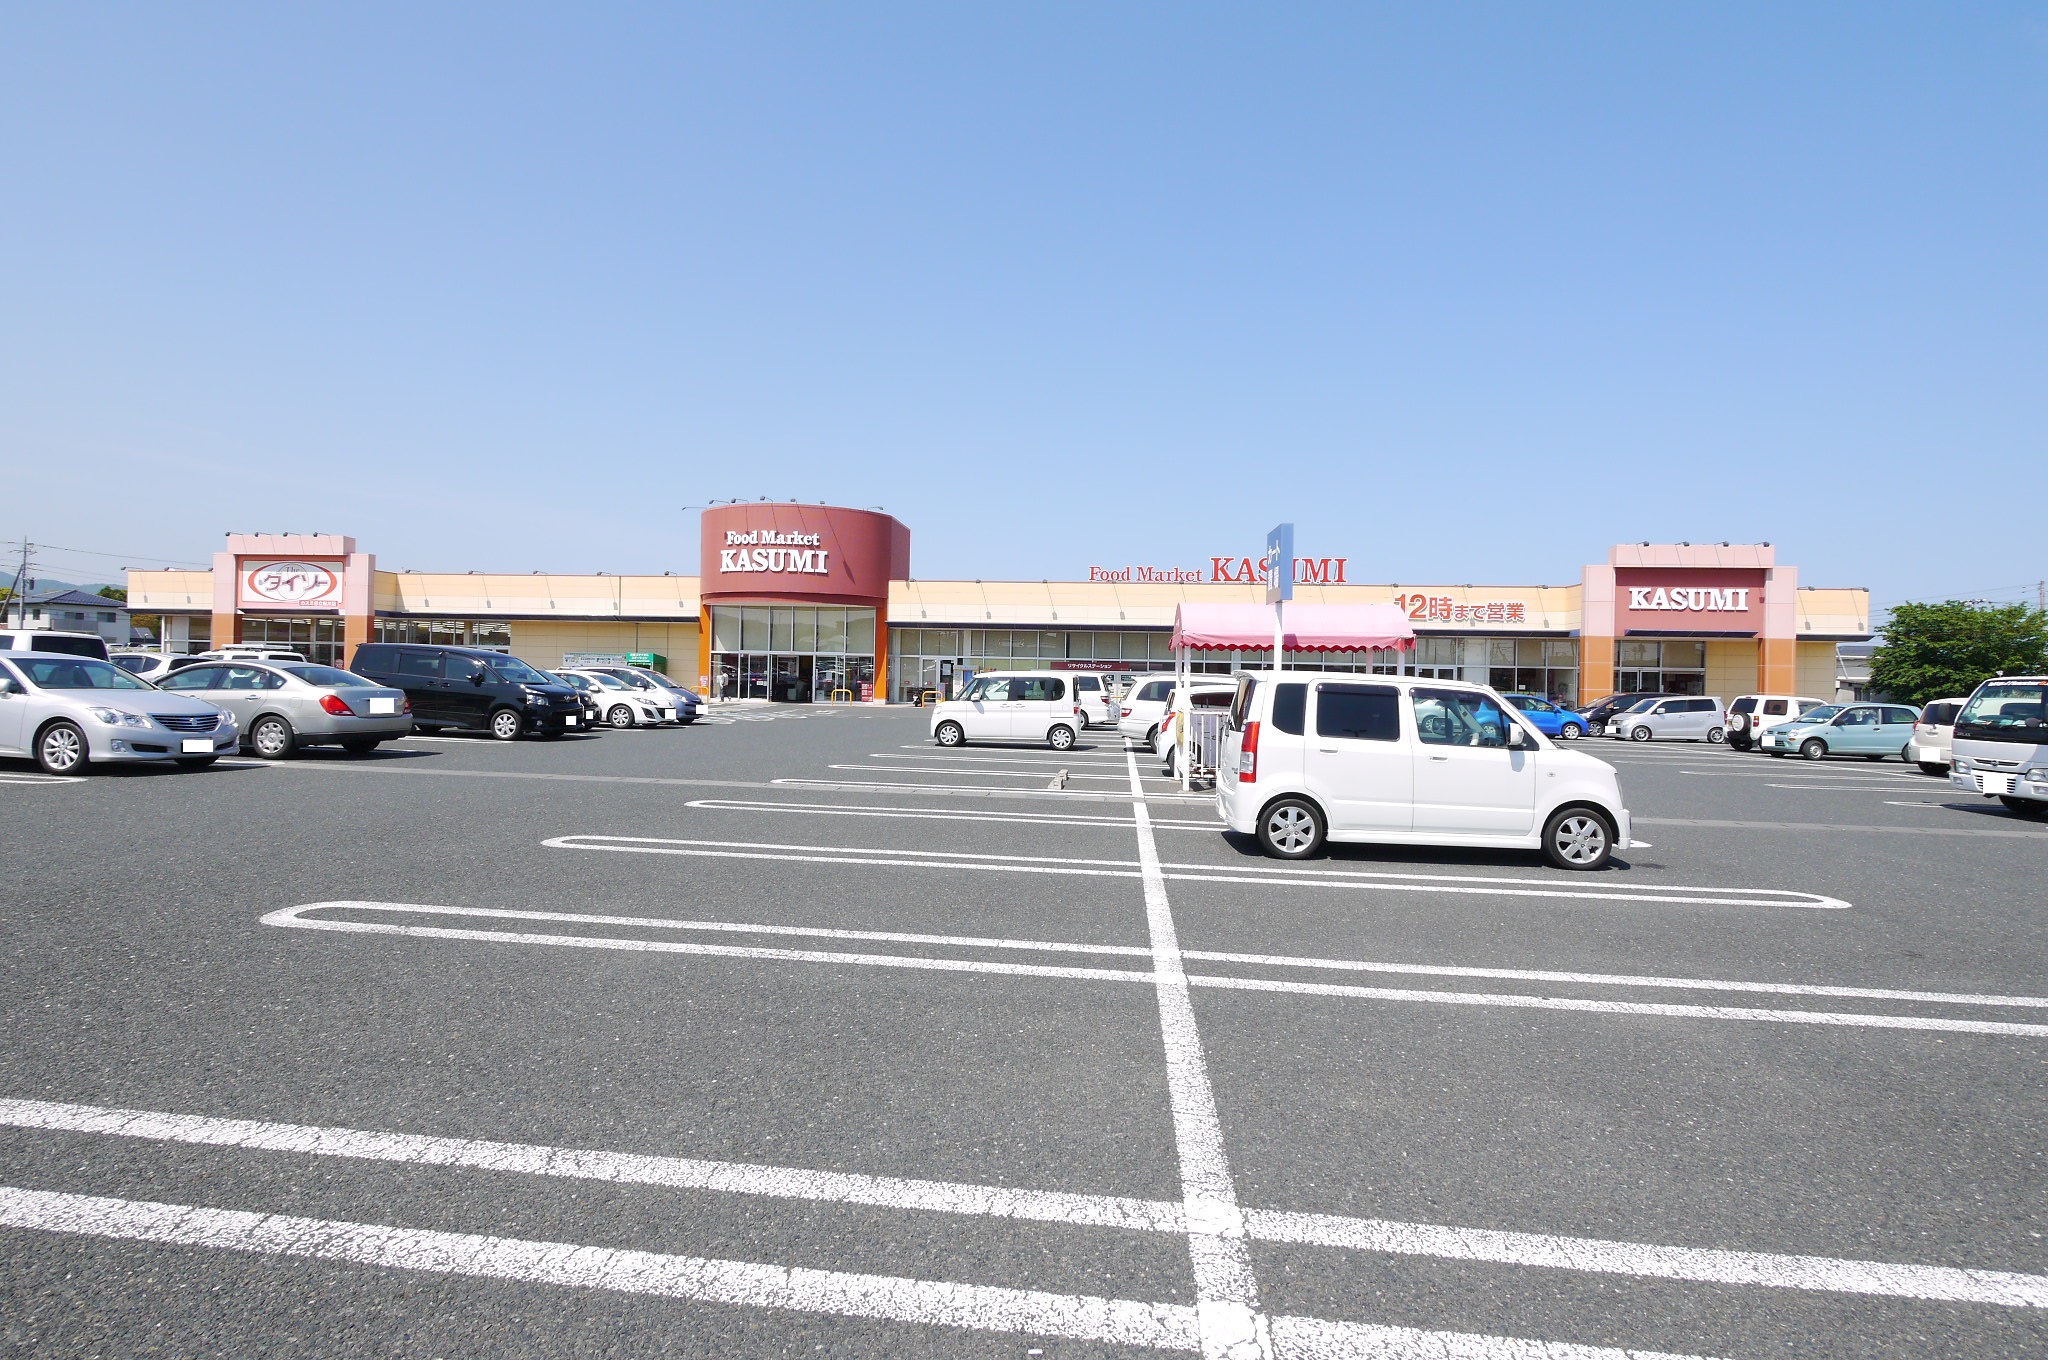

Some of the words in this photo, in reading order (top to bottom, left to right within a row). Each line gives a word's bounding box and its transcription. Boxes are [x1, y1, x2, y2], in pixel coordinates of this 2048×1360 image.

[726, 530, 758, 545] Food
[761, 530, 820, 546] Market
[720, 548, 828, 574] KASUMI
[1088, 566, 1131, 582] Food
[1136, 566, 1202, 582] Market
[1210, 557, 1347, 583] KASMI
[264, 574, 328, 591] ダイソー
[1394, 594, 1525, 621] 12時まで営業
[1628, 587, 1749, 611] KASUMI
